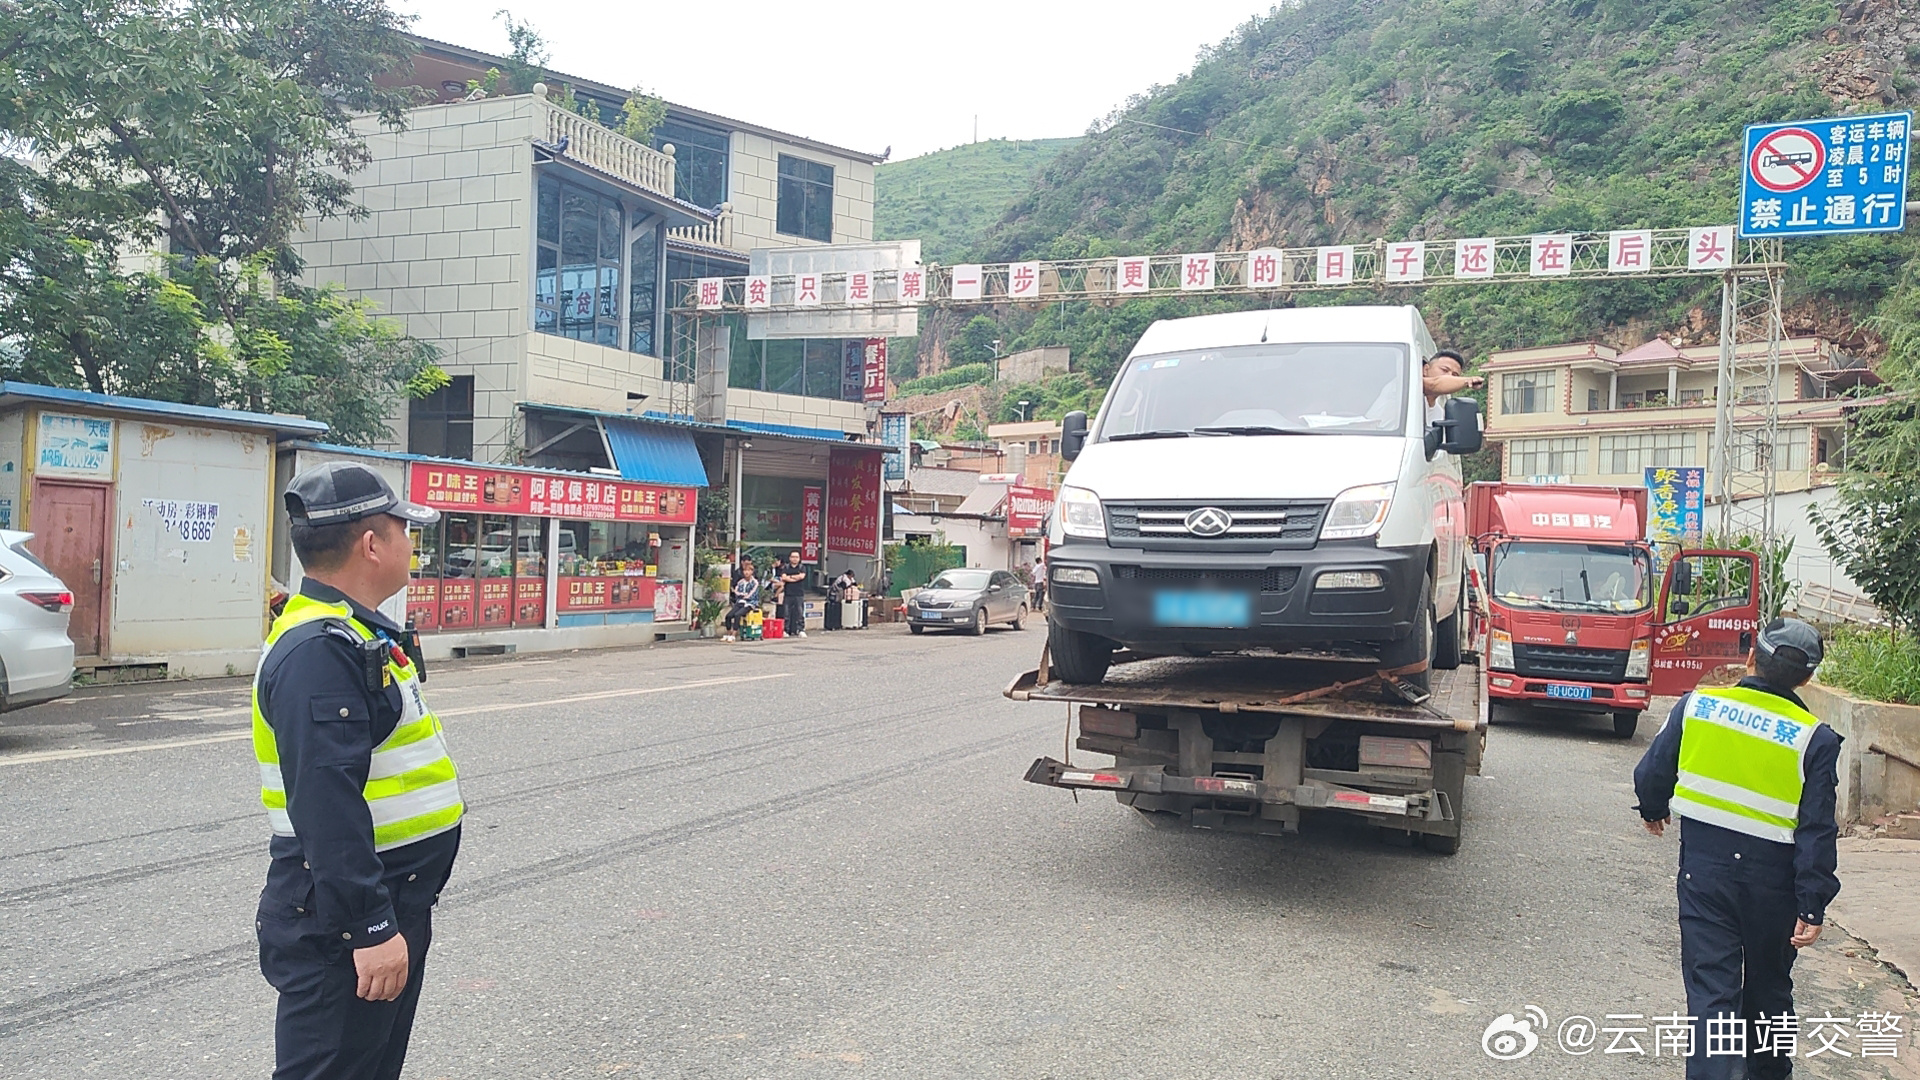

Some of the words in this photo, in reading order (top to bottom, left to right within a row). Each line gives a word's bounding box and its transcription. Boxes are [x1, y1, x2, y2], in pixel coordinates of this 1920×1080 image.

[1829, 120, 1905, 145] 客运车辆
[1750, 193, 1896, 230] 禁止通行
[428, 472, 478, 490] 口味王
[530, 477, 617, 504] 阿都便利店
[621, 489, 656, 504] 口味王
[804, 492, 821, 557] 黄焖排骨
[1532, 512, 1612, 529] 中国重汽
[570, 582, 605, 594] 口味王
[1694, 696, 1720, 719] 警
[1718, 705, 1772, 733] POLICE
[1772, 718, 1801, 745] 察
[367, 919, 389, 935] POLICE
